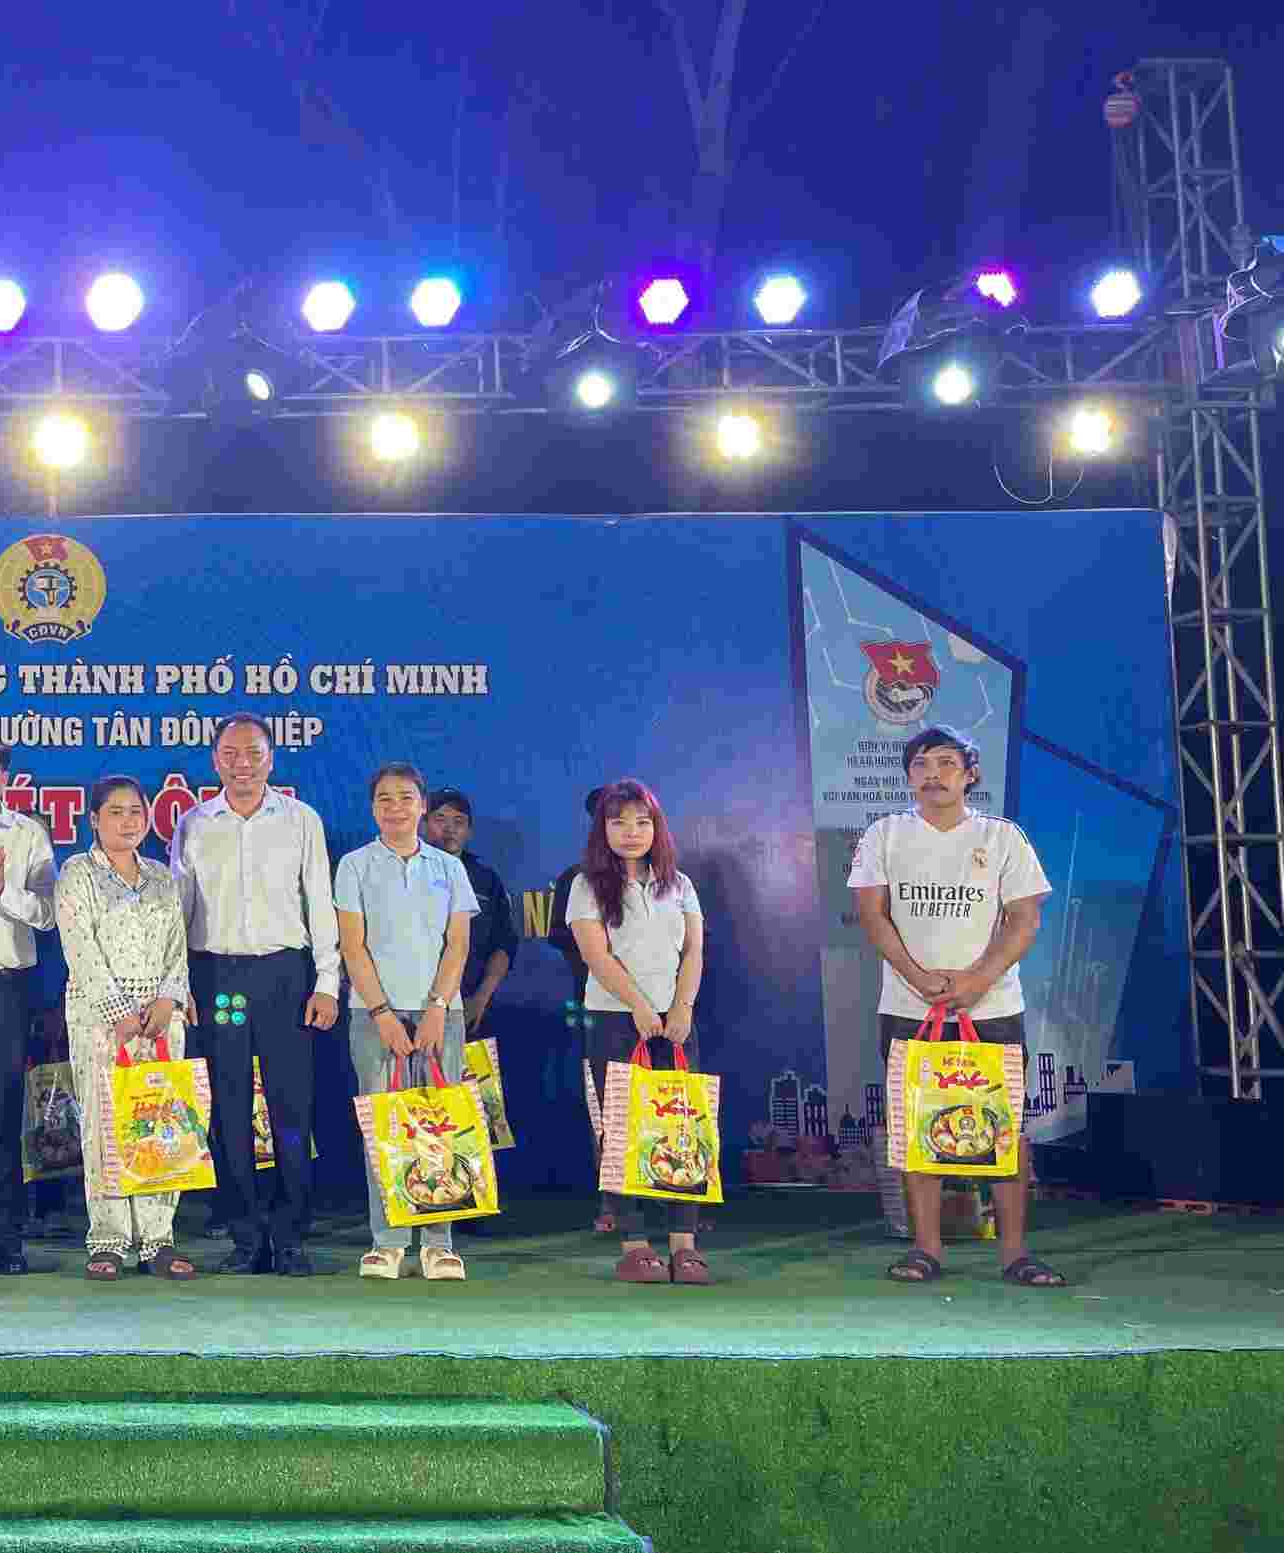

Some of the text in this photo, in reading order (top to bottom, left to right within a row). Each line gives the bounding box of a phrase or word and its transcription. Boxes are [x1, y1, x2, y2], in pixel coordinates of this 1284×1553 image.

[18, 657, 145, 695] THÀNH
[155, 654, 235, 694] PHỐ
[244, 653, 299, 694] HỒ
[309, 658, 376, 695] CHÍ
[386, 664, 488, 695] MINH
[91, 710, 152, 747] TÂN
[159, 711, 218, 748] ĐÔN
[898, 882, 985, 903] Emirates
[928, 902, 972, 918] BETTER
